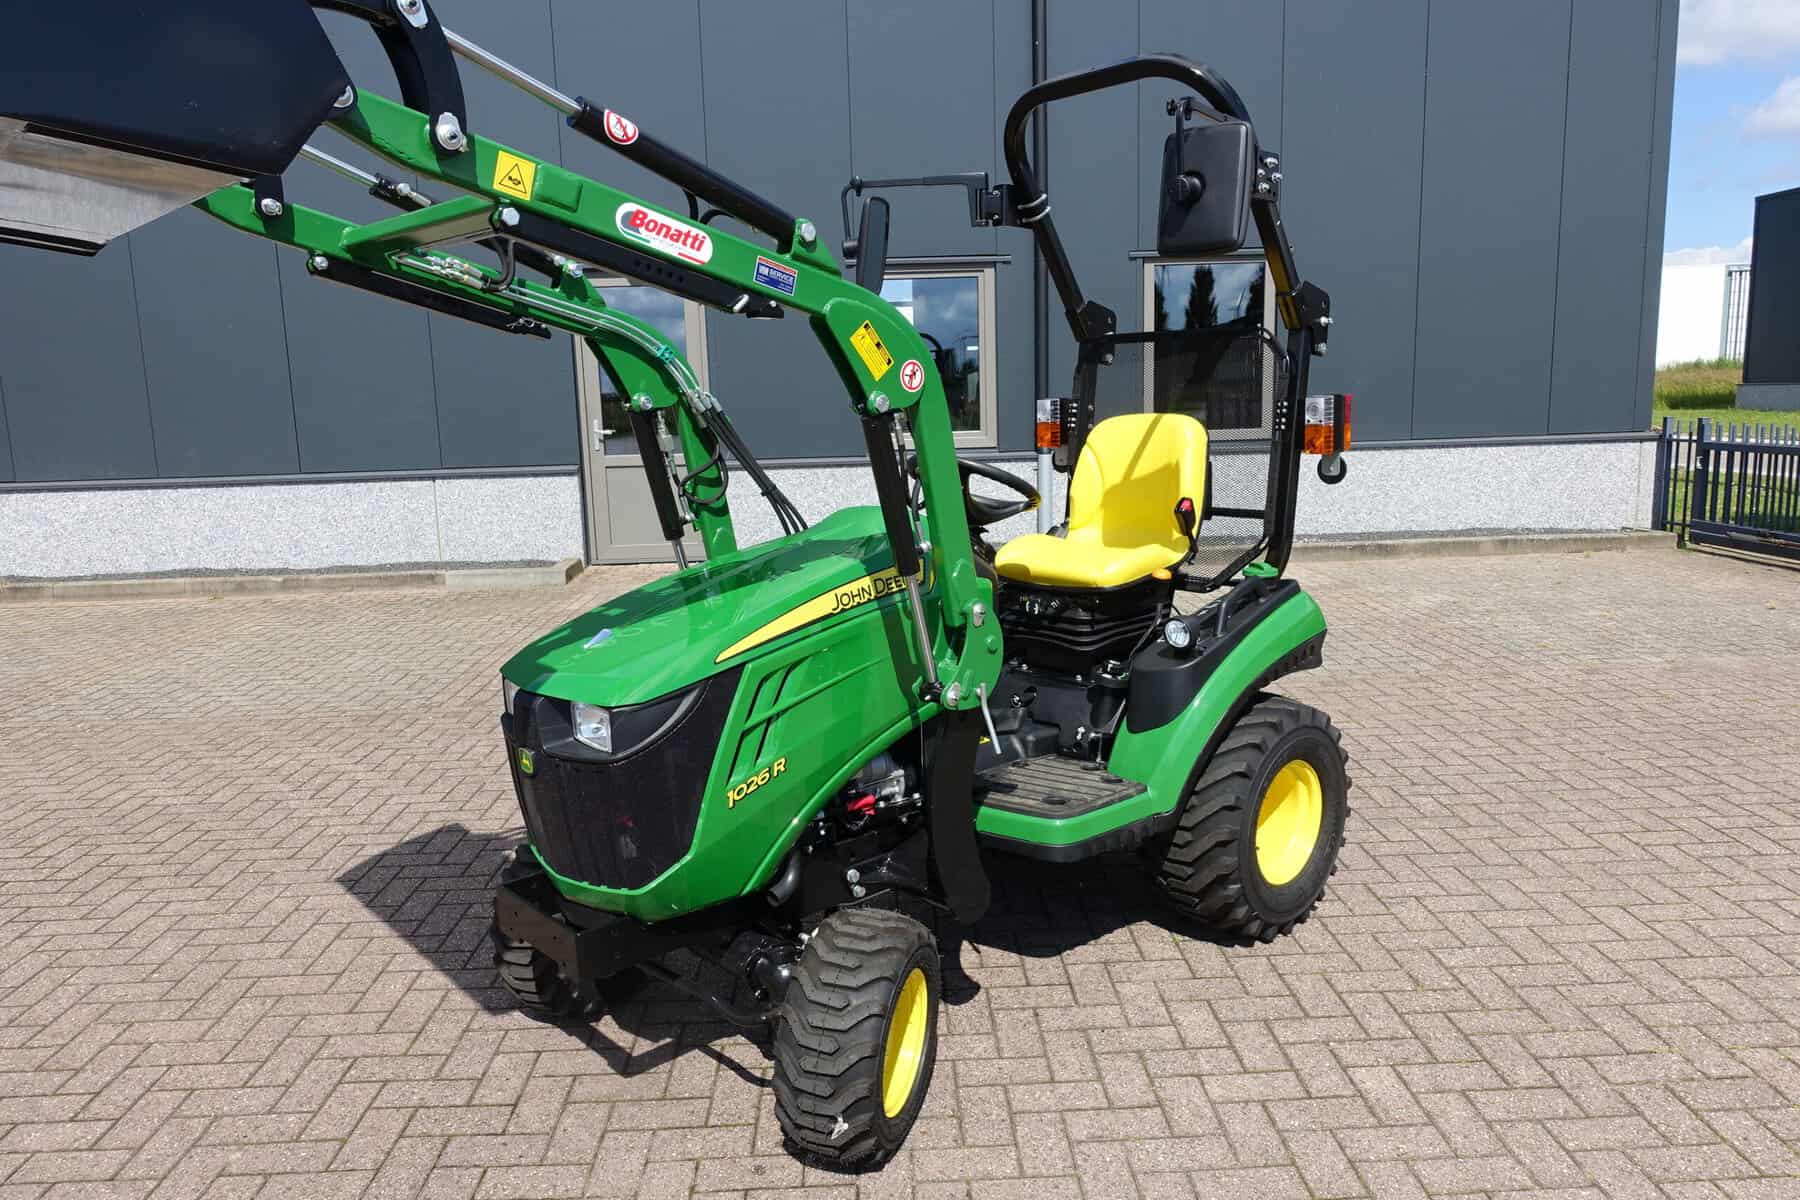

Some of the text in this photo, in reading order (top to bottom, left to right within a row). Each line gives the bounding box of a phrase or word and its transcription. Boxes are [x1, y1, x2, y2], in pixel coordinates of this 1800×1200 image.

[629, 208, 706, 252] Bonatti
[832, 575, 907, 611] JOHN DEE
[727, 757, 786, 809] 1026 R
